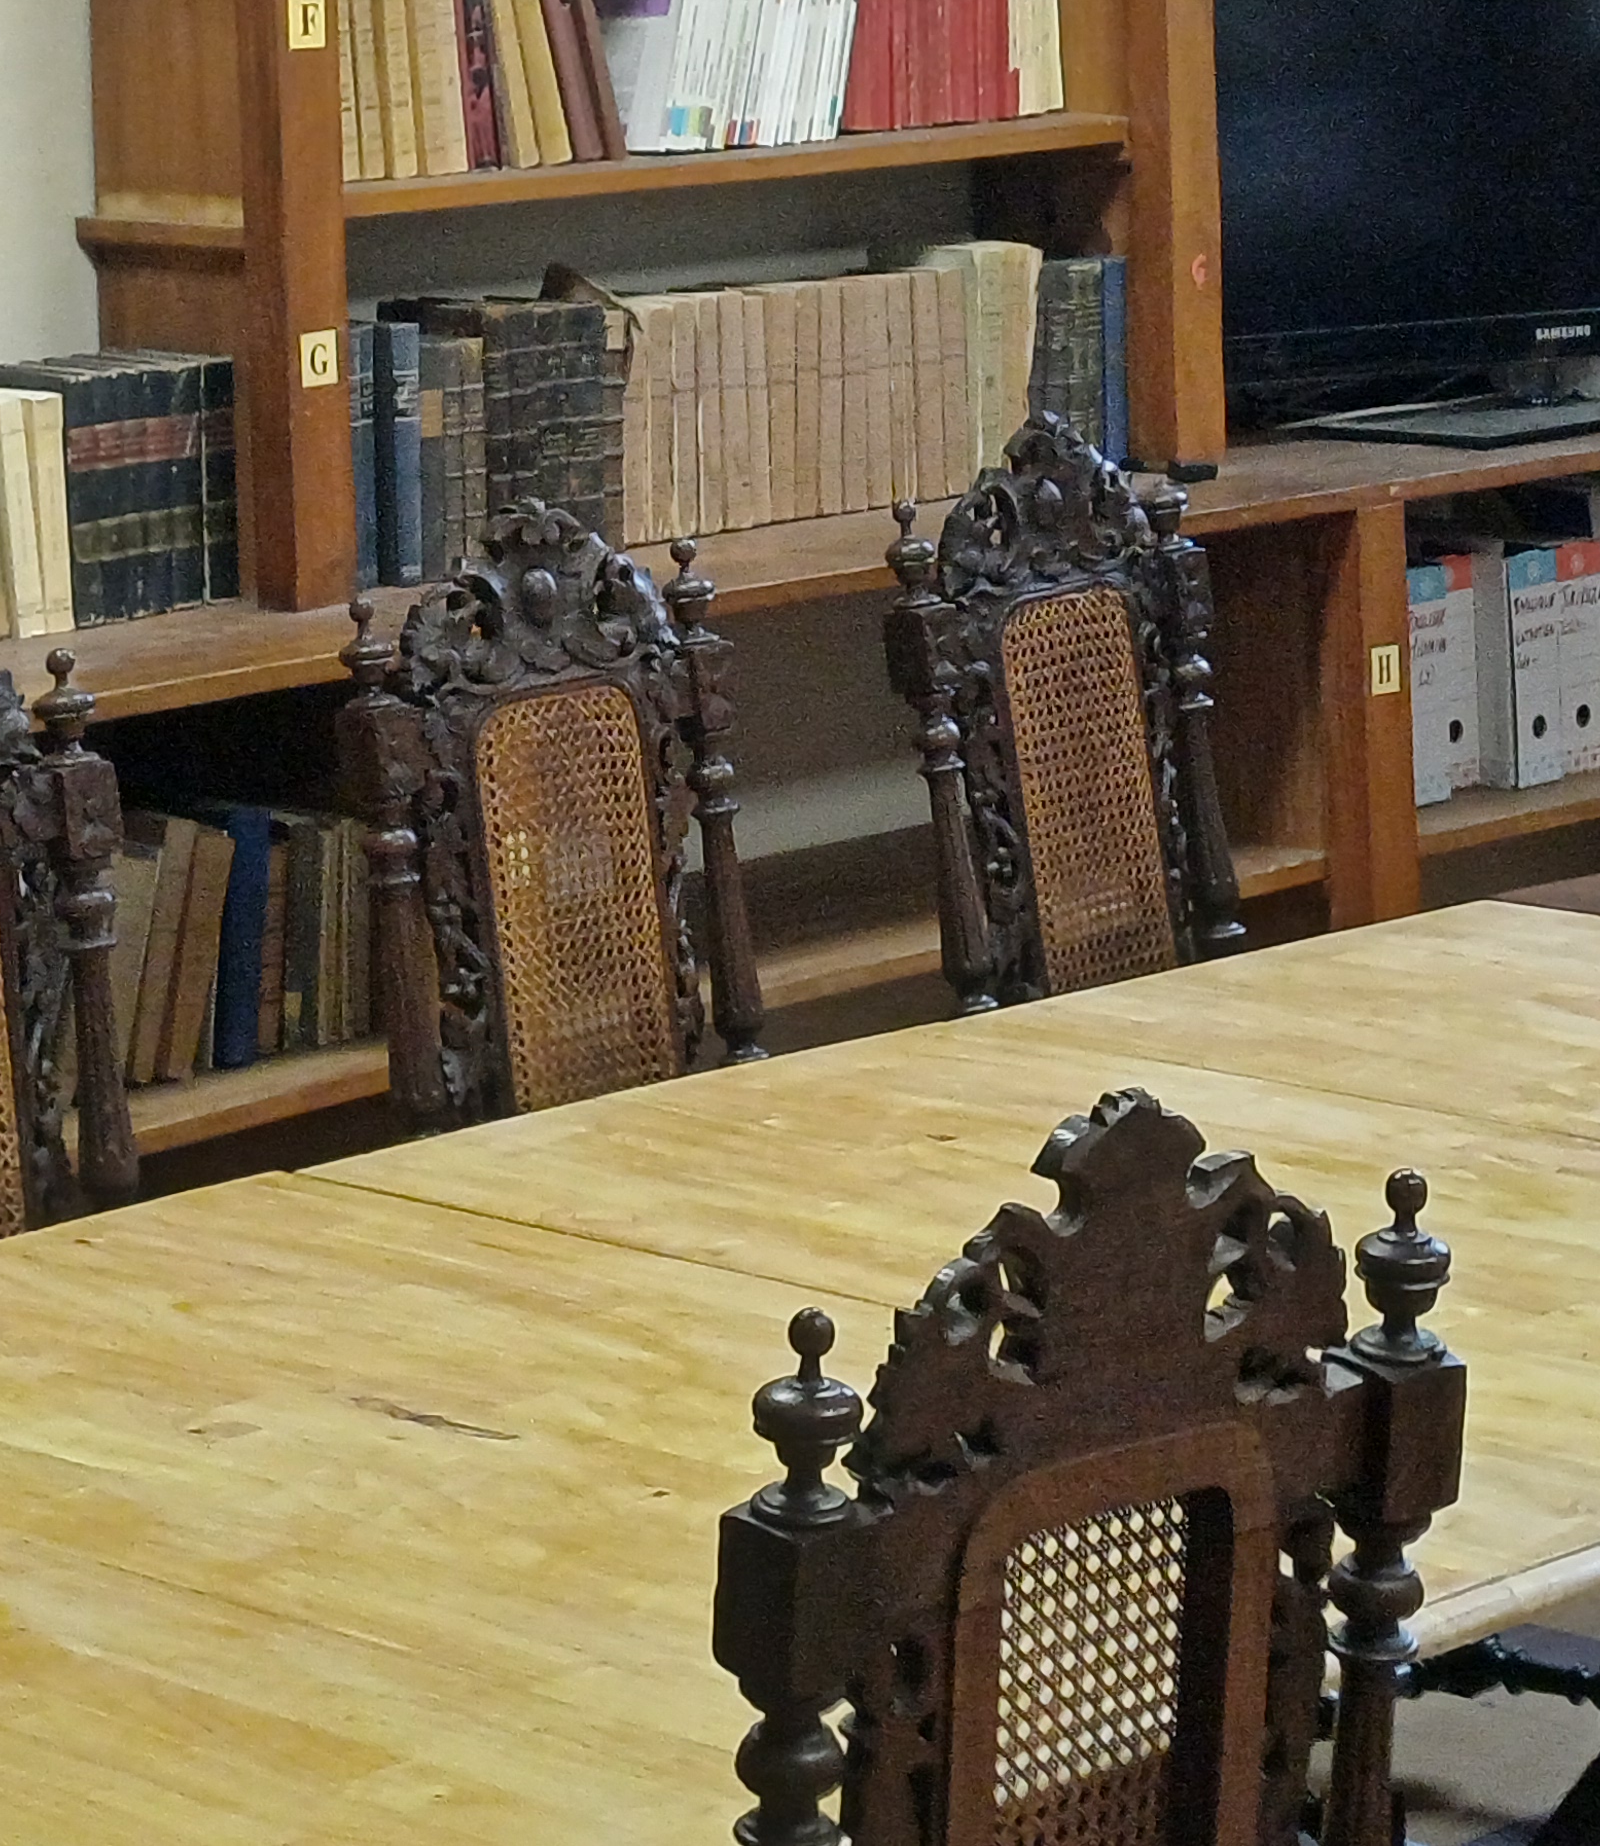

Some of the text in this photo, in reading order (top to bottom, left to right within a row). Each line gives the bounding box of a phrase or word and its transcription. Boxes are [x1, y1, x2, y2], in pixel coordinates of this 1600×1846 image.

[301, 3, 319, 37] F
[1535, 325, 1591, 341] SAMSUNG
[310, 342, 329, 376] G
[1378, 653, 1391, 685] H
